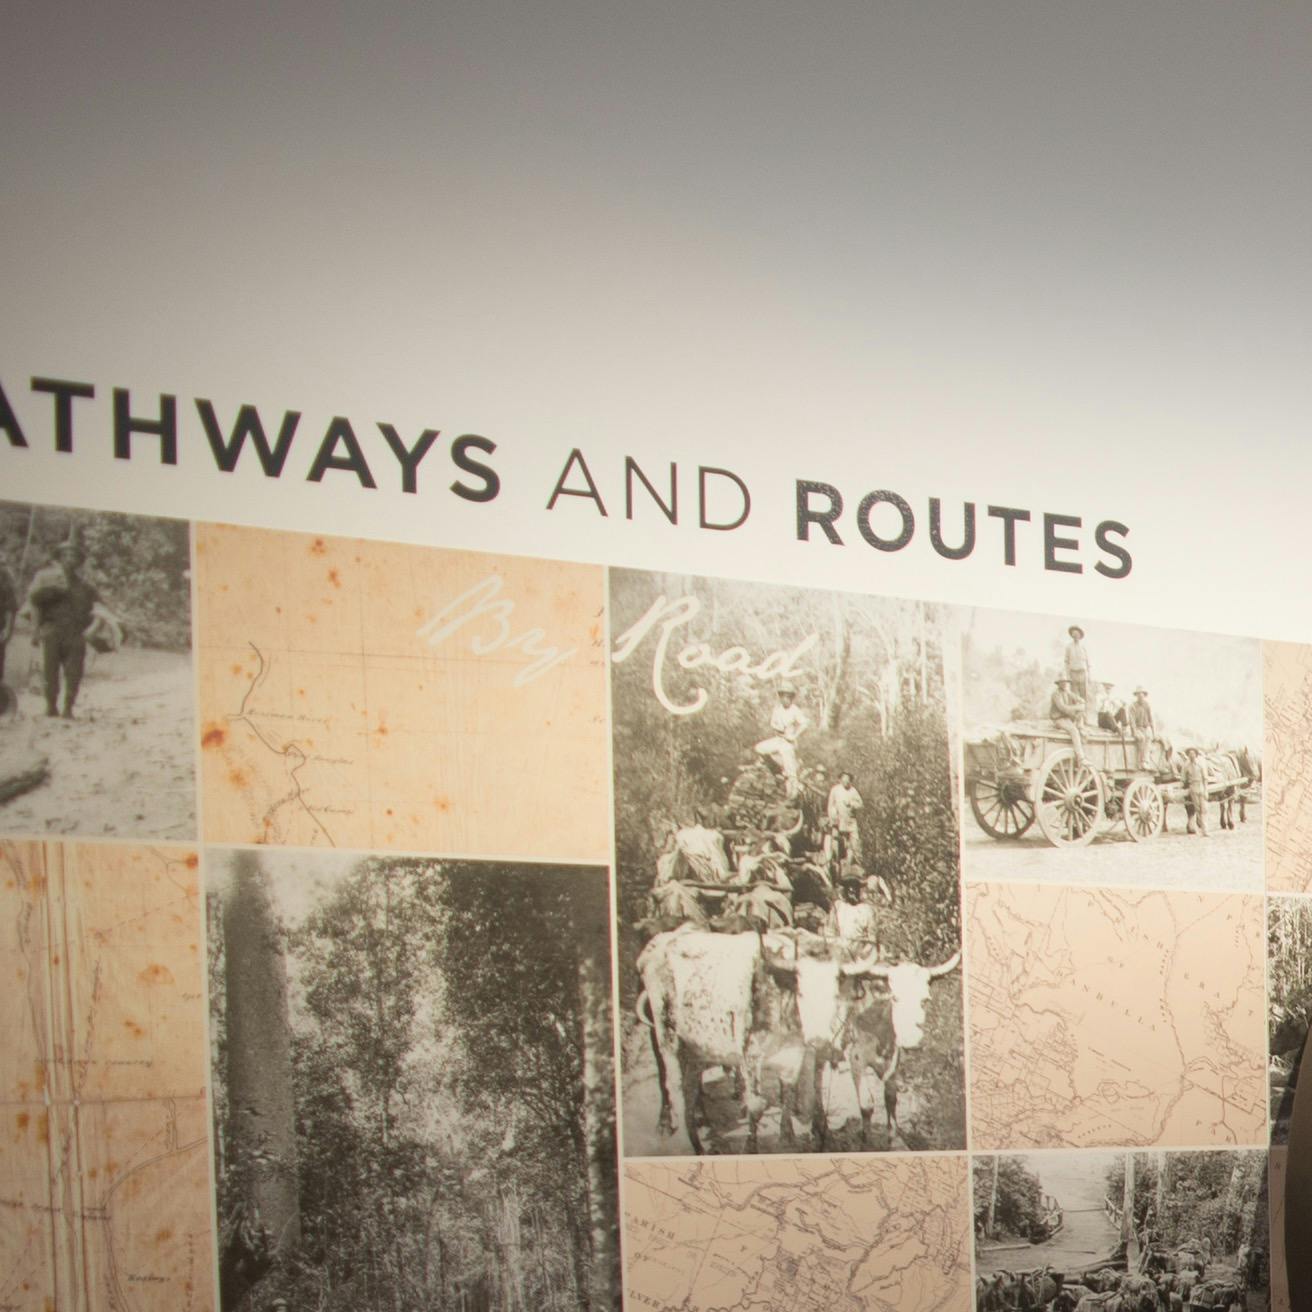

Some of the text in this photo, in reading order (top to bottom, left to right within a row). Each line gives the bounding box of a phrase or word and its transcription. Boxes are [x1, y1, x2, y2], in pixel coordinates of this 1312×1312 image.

[546, 445, 752, 532] AND
[795, 478, 1134, 581] ROUTES
[612, 595, 819, 715] Road
